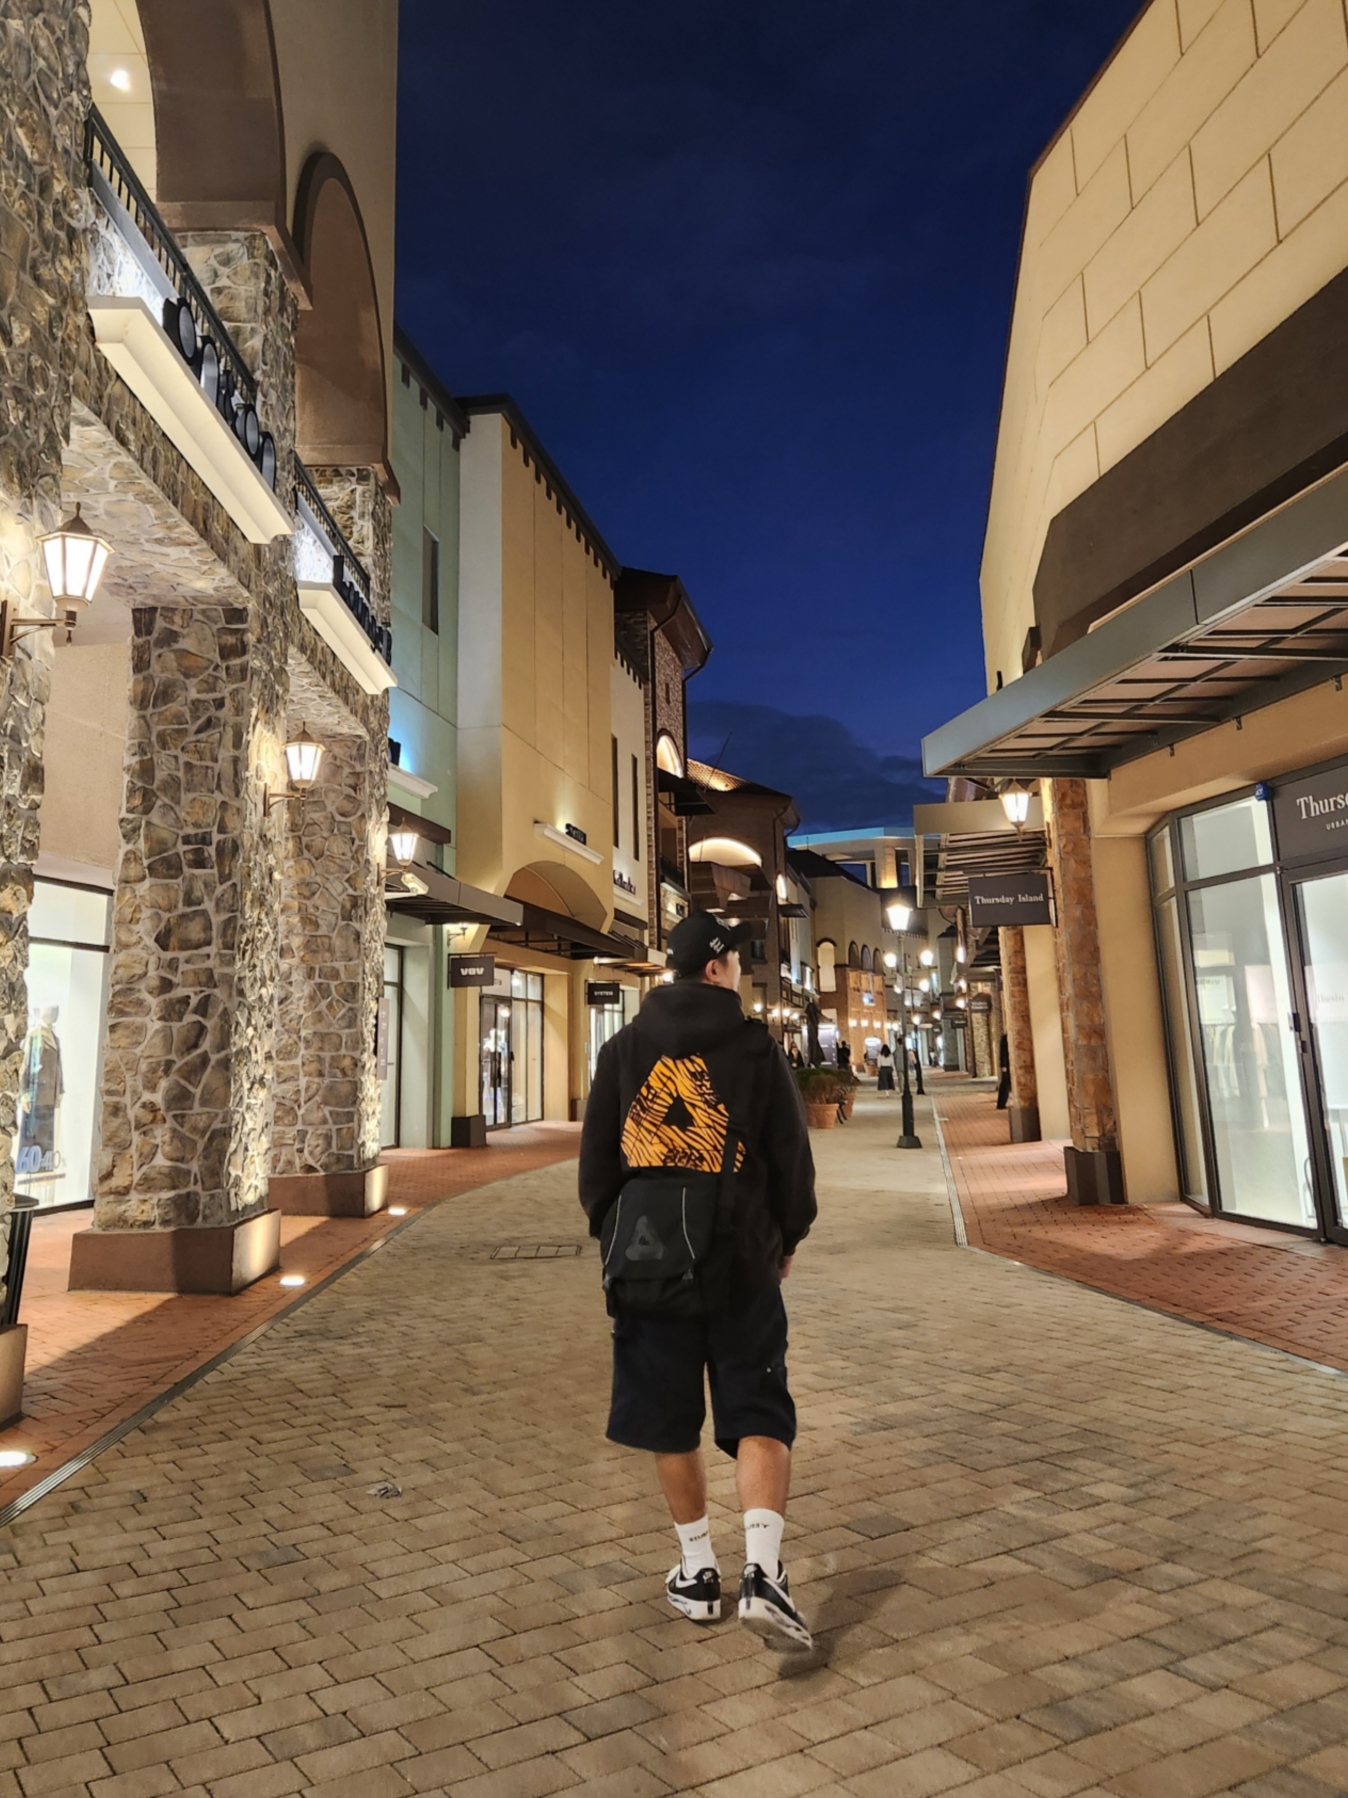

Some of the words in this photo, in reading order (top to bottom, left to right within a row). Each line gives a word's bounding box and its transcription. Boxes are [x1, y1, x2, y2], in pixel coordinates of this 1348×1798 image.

[974, 894, 1015, 905] Thursday
[1017, 892, 1044, 903] Island
[460, 967, 485, 976] VOV
